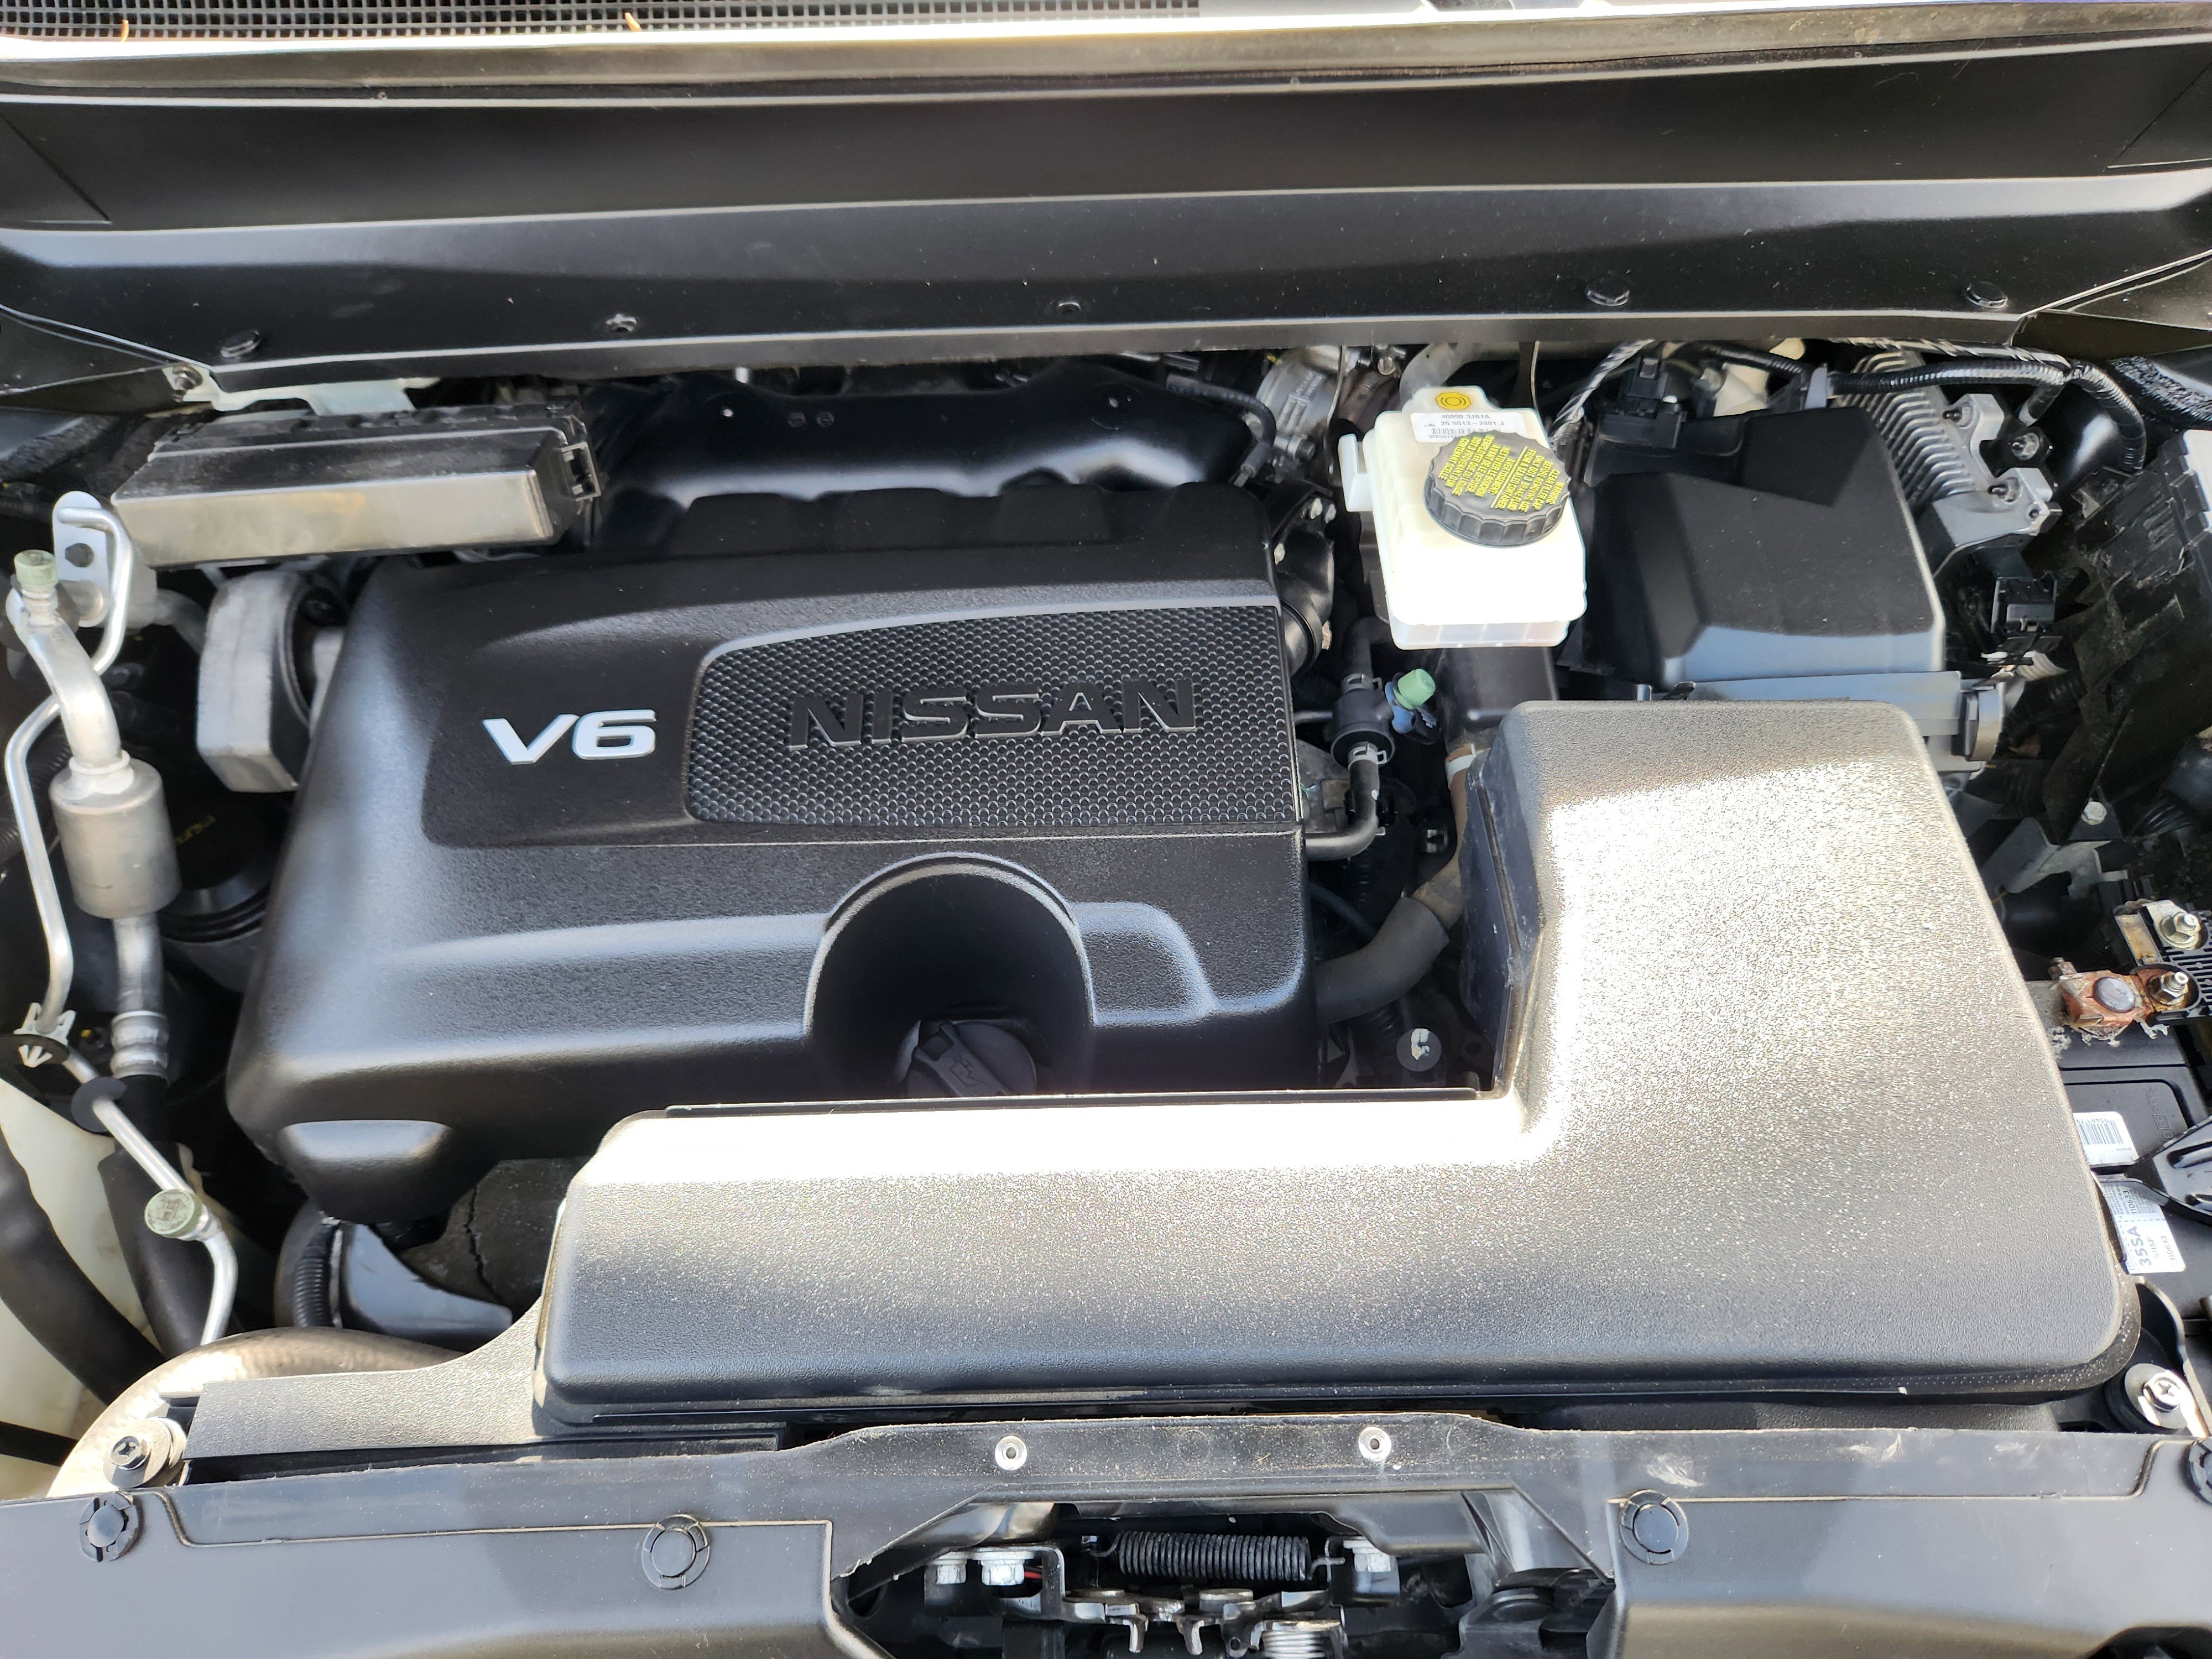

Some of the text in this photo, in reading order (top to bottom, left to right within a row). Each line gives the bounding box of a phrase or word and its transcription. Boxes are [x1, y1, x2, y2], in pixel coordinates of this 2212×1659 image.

[1448, 438, 1469, 463] CONTENANT
[1468, 436, 1481, 448] DOT
[1484, 443, 1499, 461] AVANT
[1521, 448, 1536, 463] FROM
[1531, 454, 1544, 467] ONLY
[1452, 448, 1473, 477] PROVENANT
[1465, 461, 1478, 473] QUE
[1475, 446, 1510, 497] NETTOYER LE BOUCHON
[1477, 465, 1487, 473] LE
[1480, 459, 1491, 468] DE
[1525, 466, 1537, 477] DOT
[1536, 460, 1553, 479] BEFORE
[1462, 470, 1472, 479] DU
[1510, 466, 1526, 484] SEALED
[1452, 477, 1468, 496] LIQUIDE
[1514, 481, 1529, 498] BRAKE
[1531, 469, 1560, 510] CLEAN FILLER CAP
[1507, 495, 1521, 510] FLUID
[1517, 500, 1530, 512] USE
[788, 678, 1198, 752] NISSAN
[483, 709, 656, 765] V6
[2123, 1190, 2137, 1214] 110633
[2161, 1235, 2176, 1260] 110633
